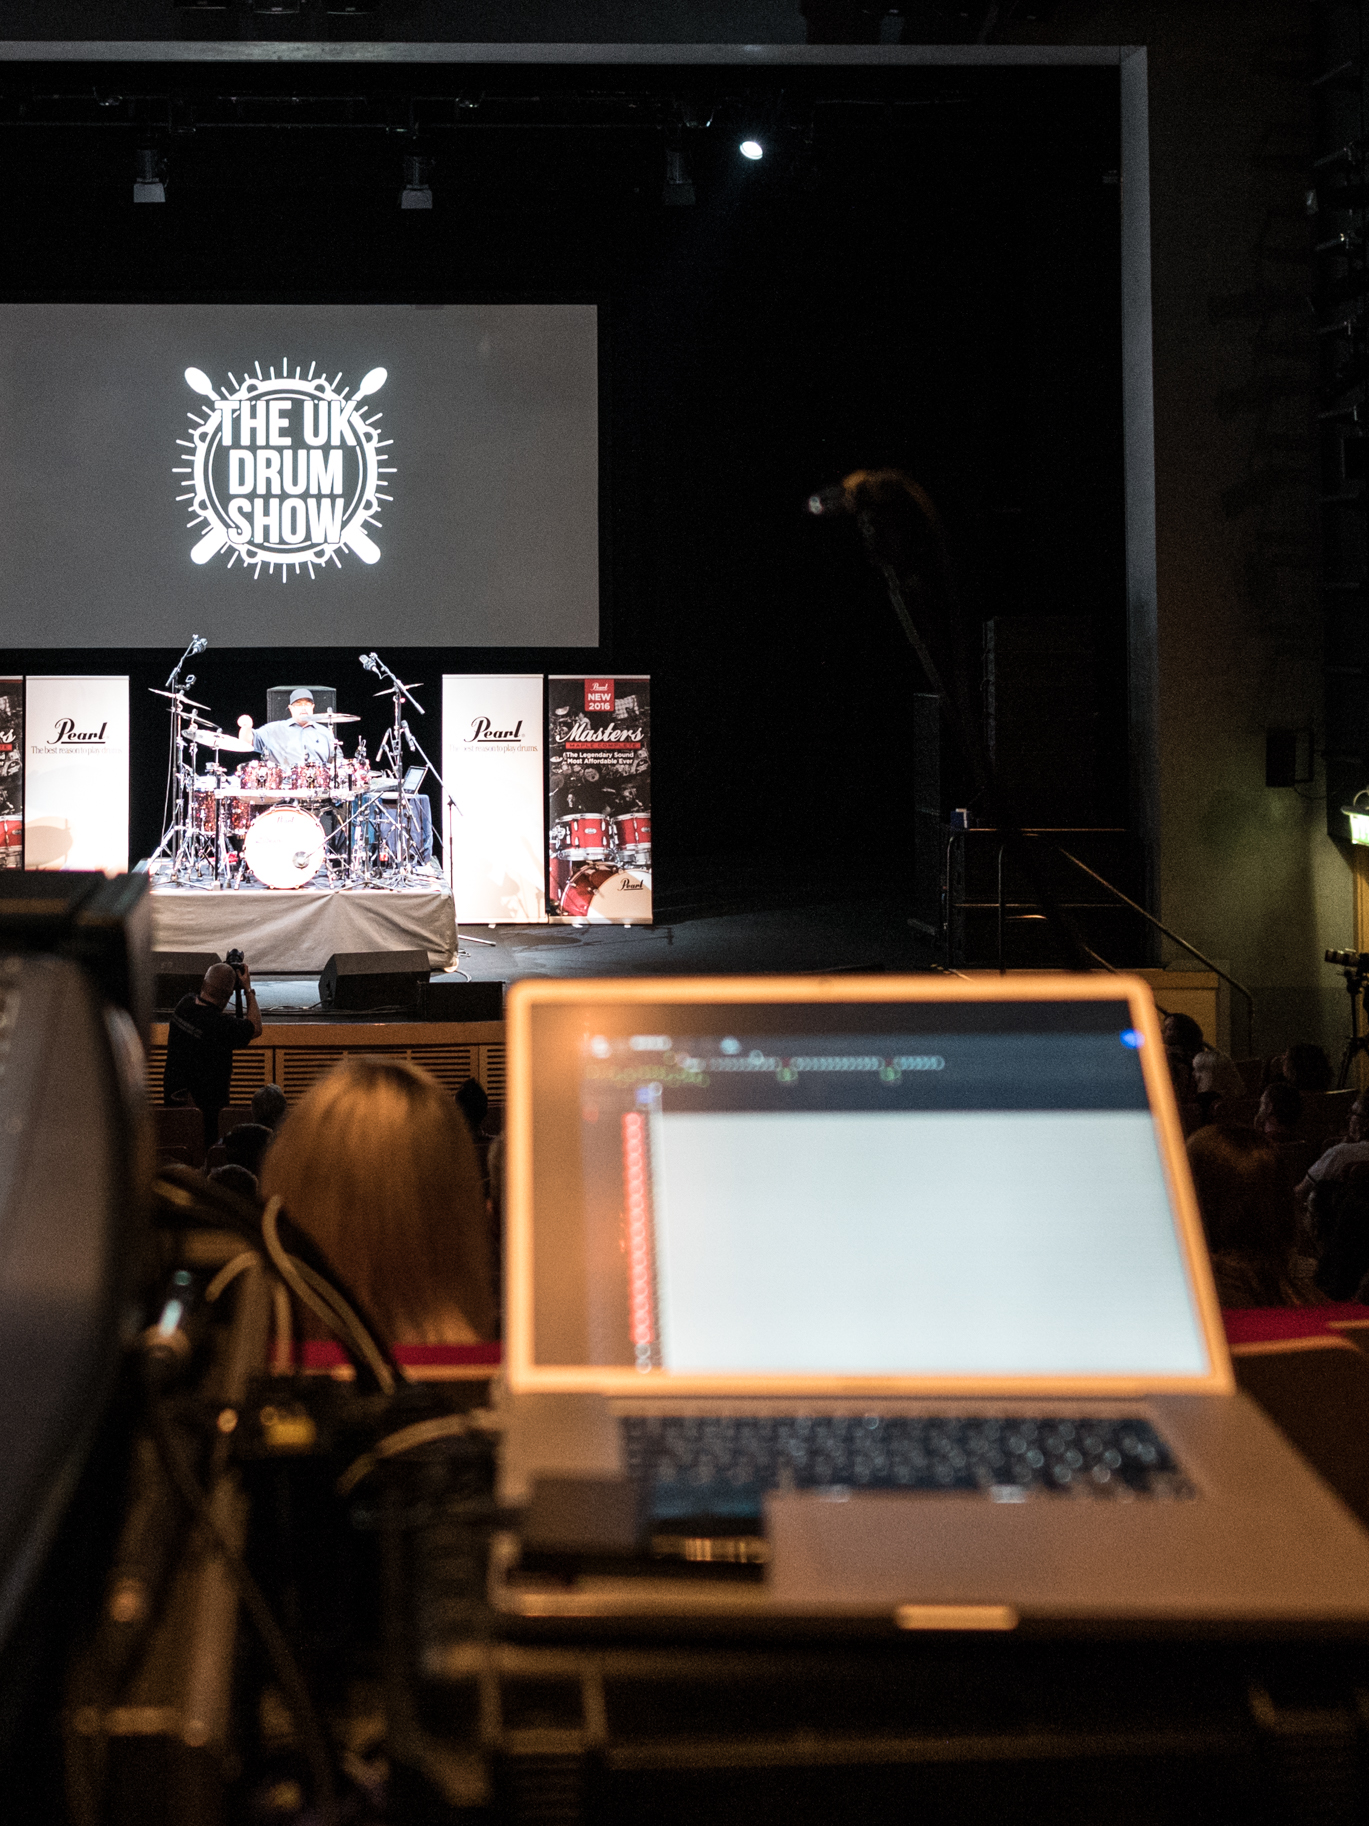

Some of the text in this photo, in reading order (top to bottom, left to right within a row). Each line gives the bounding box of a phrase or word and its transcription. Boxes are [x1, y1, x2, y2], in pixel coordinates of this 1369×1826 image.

[215, 400, 358, 446] THE UK
[229, 449, 343, 495] DRUM
[227, 498, 345, 544] SHOW
[587, 693, 612, 701] NEW
[588, 702, 611, 710] 2016
[46, 717, 108, 745] Pearl
[463, 716, 523, 743] Pearl
[555, 722, 644, 743] Masters
[31, 745, 44, 754] The
[44, 745, 58, 754] best
[503, 744, 517, 753] play
[617, 878, 644, 891] Pearl
